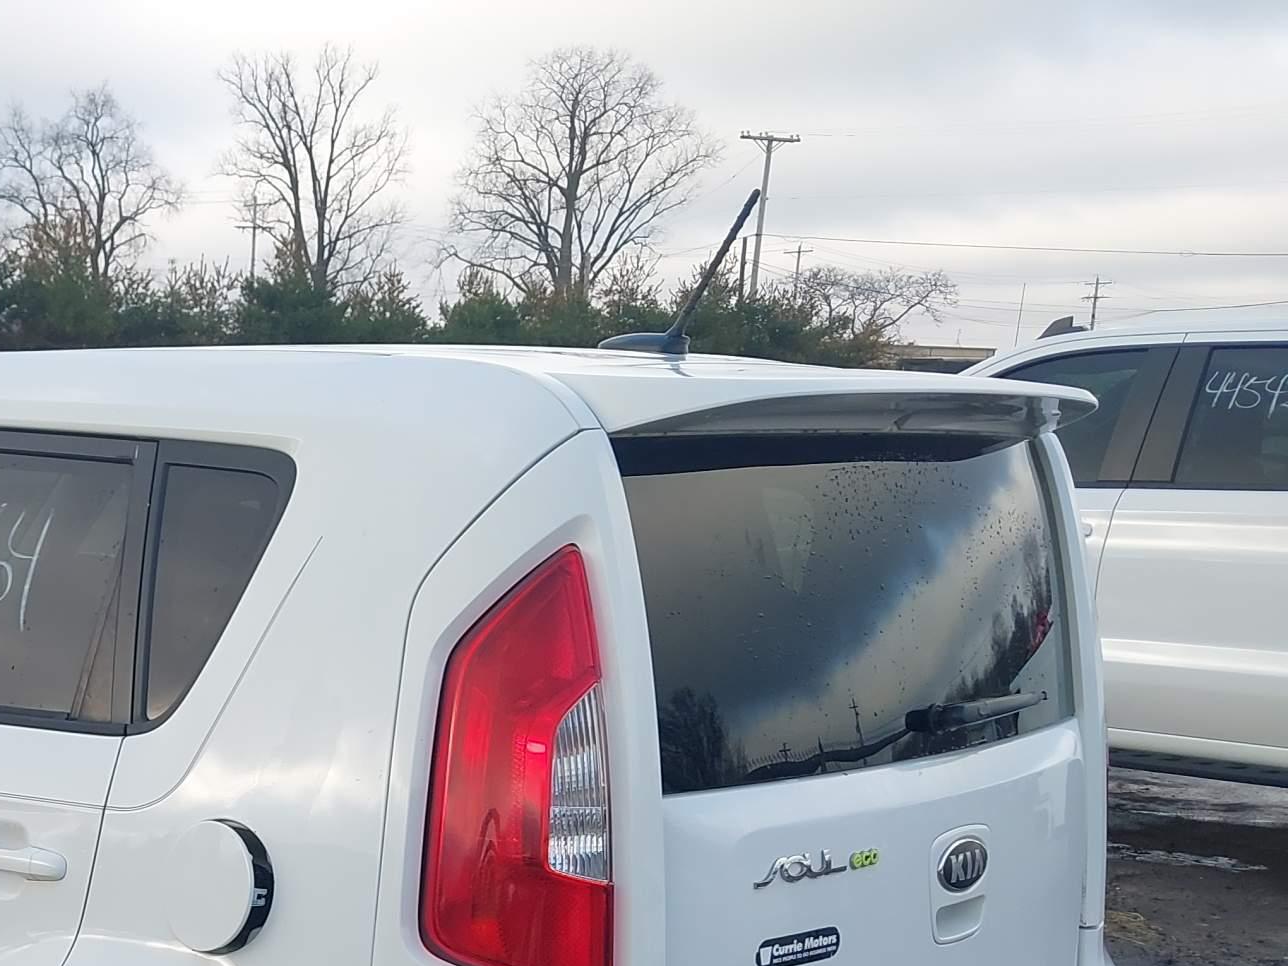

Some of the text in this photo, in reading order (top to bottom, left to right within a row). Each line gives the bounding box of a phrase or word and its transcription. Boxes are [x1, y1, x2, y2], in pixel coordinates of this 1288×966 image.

[1205, 371, 1288, 419] 4454
[753, 848, 879, 890] SOUL eco
[950, 848, 984, 883] KIA
[773, 939, 803, 956] Currie
[804, 934, 837, 950] Motors
